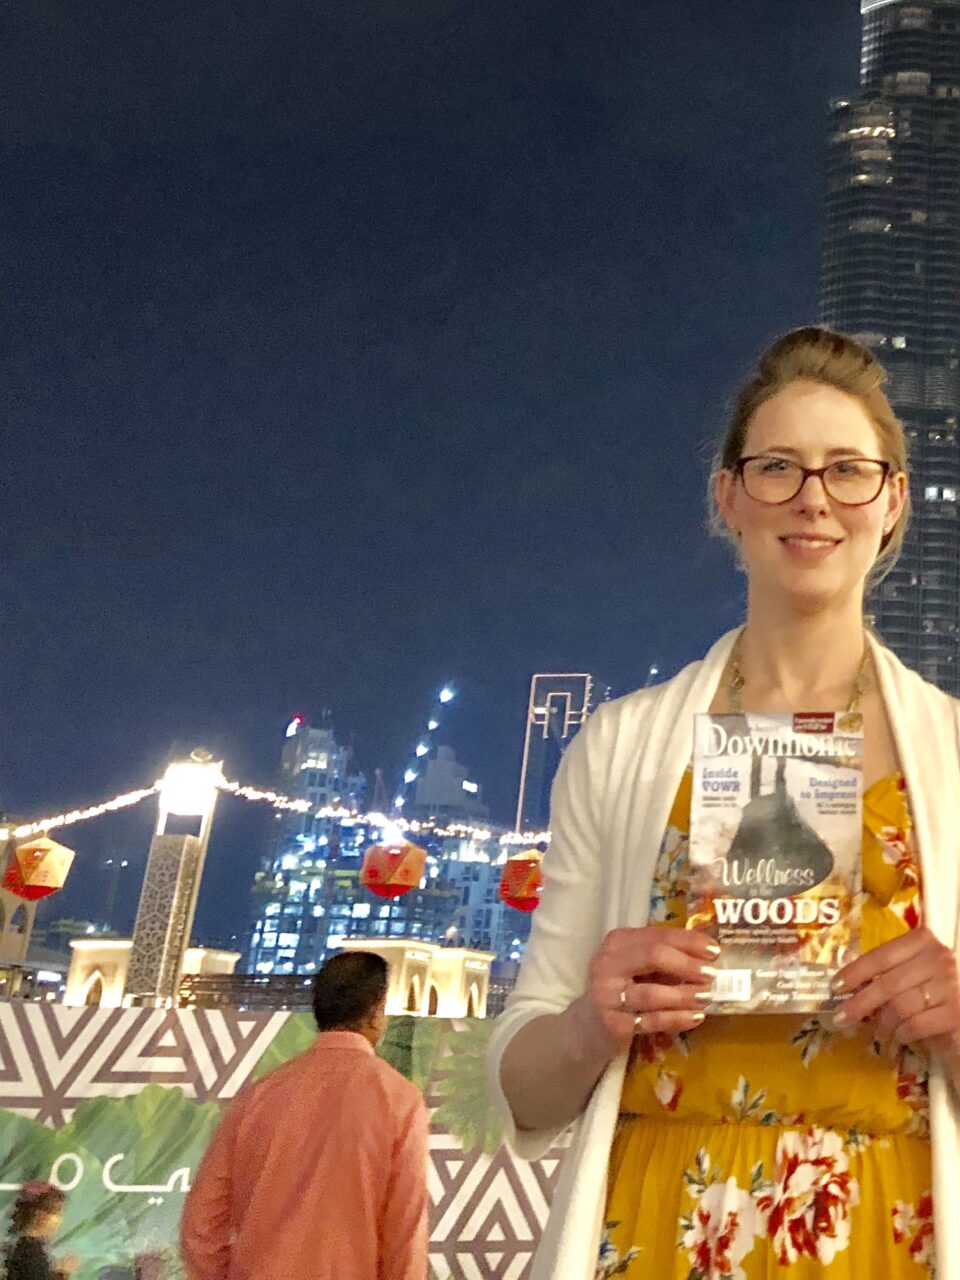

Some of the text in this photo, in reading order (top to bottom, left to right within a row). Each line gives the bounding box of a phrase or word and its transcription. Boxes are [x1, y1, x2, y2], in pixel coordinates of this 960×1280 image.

[702, 767, 739, 779] Inside
[809, 776, 858, 790] Designed
[815, 788, 857, 801] Impress
[713, 857, 815, 887] Wellness
[712, 897, 841, 925] WOODS
